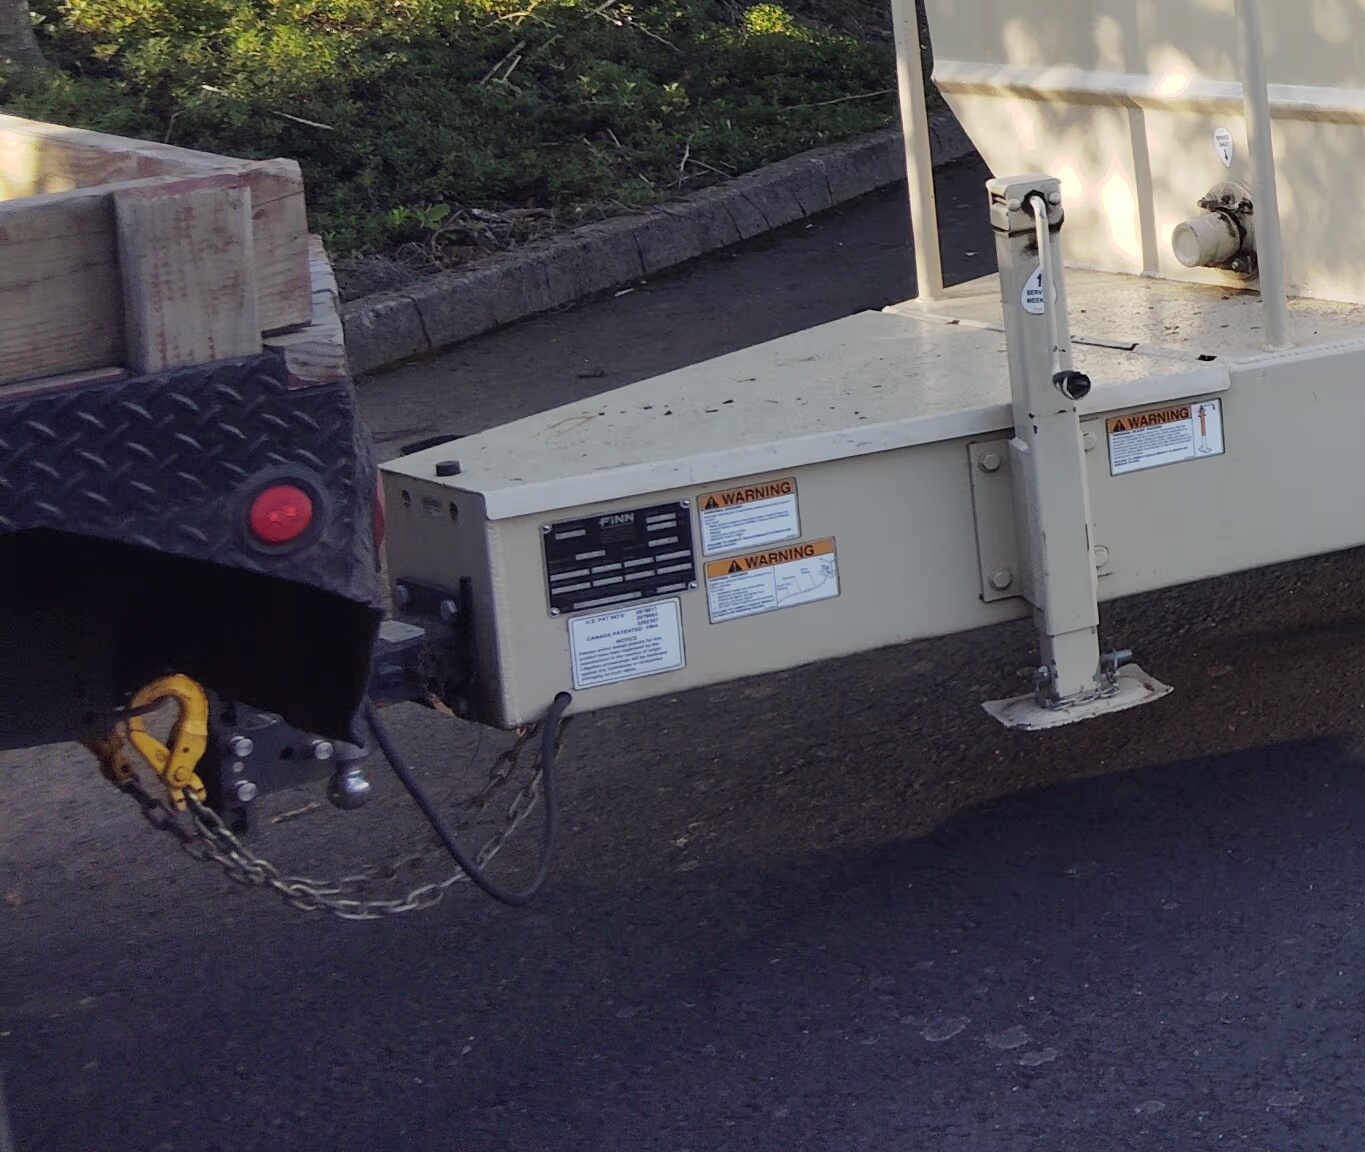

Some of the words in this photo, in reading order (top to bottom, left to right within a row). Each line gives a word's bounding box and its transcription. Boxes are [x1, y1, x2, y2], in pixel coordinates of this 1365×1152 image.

[1128, 407, 1189, 428] WARNING
[721, 482, 792, 505] WARNING
[744, 545, 815, 569] WARNING
[587, 631, 611, 641] CANADA
[612, 626, 643, 637] PATENTED
